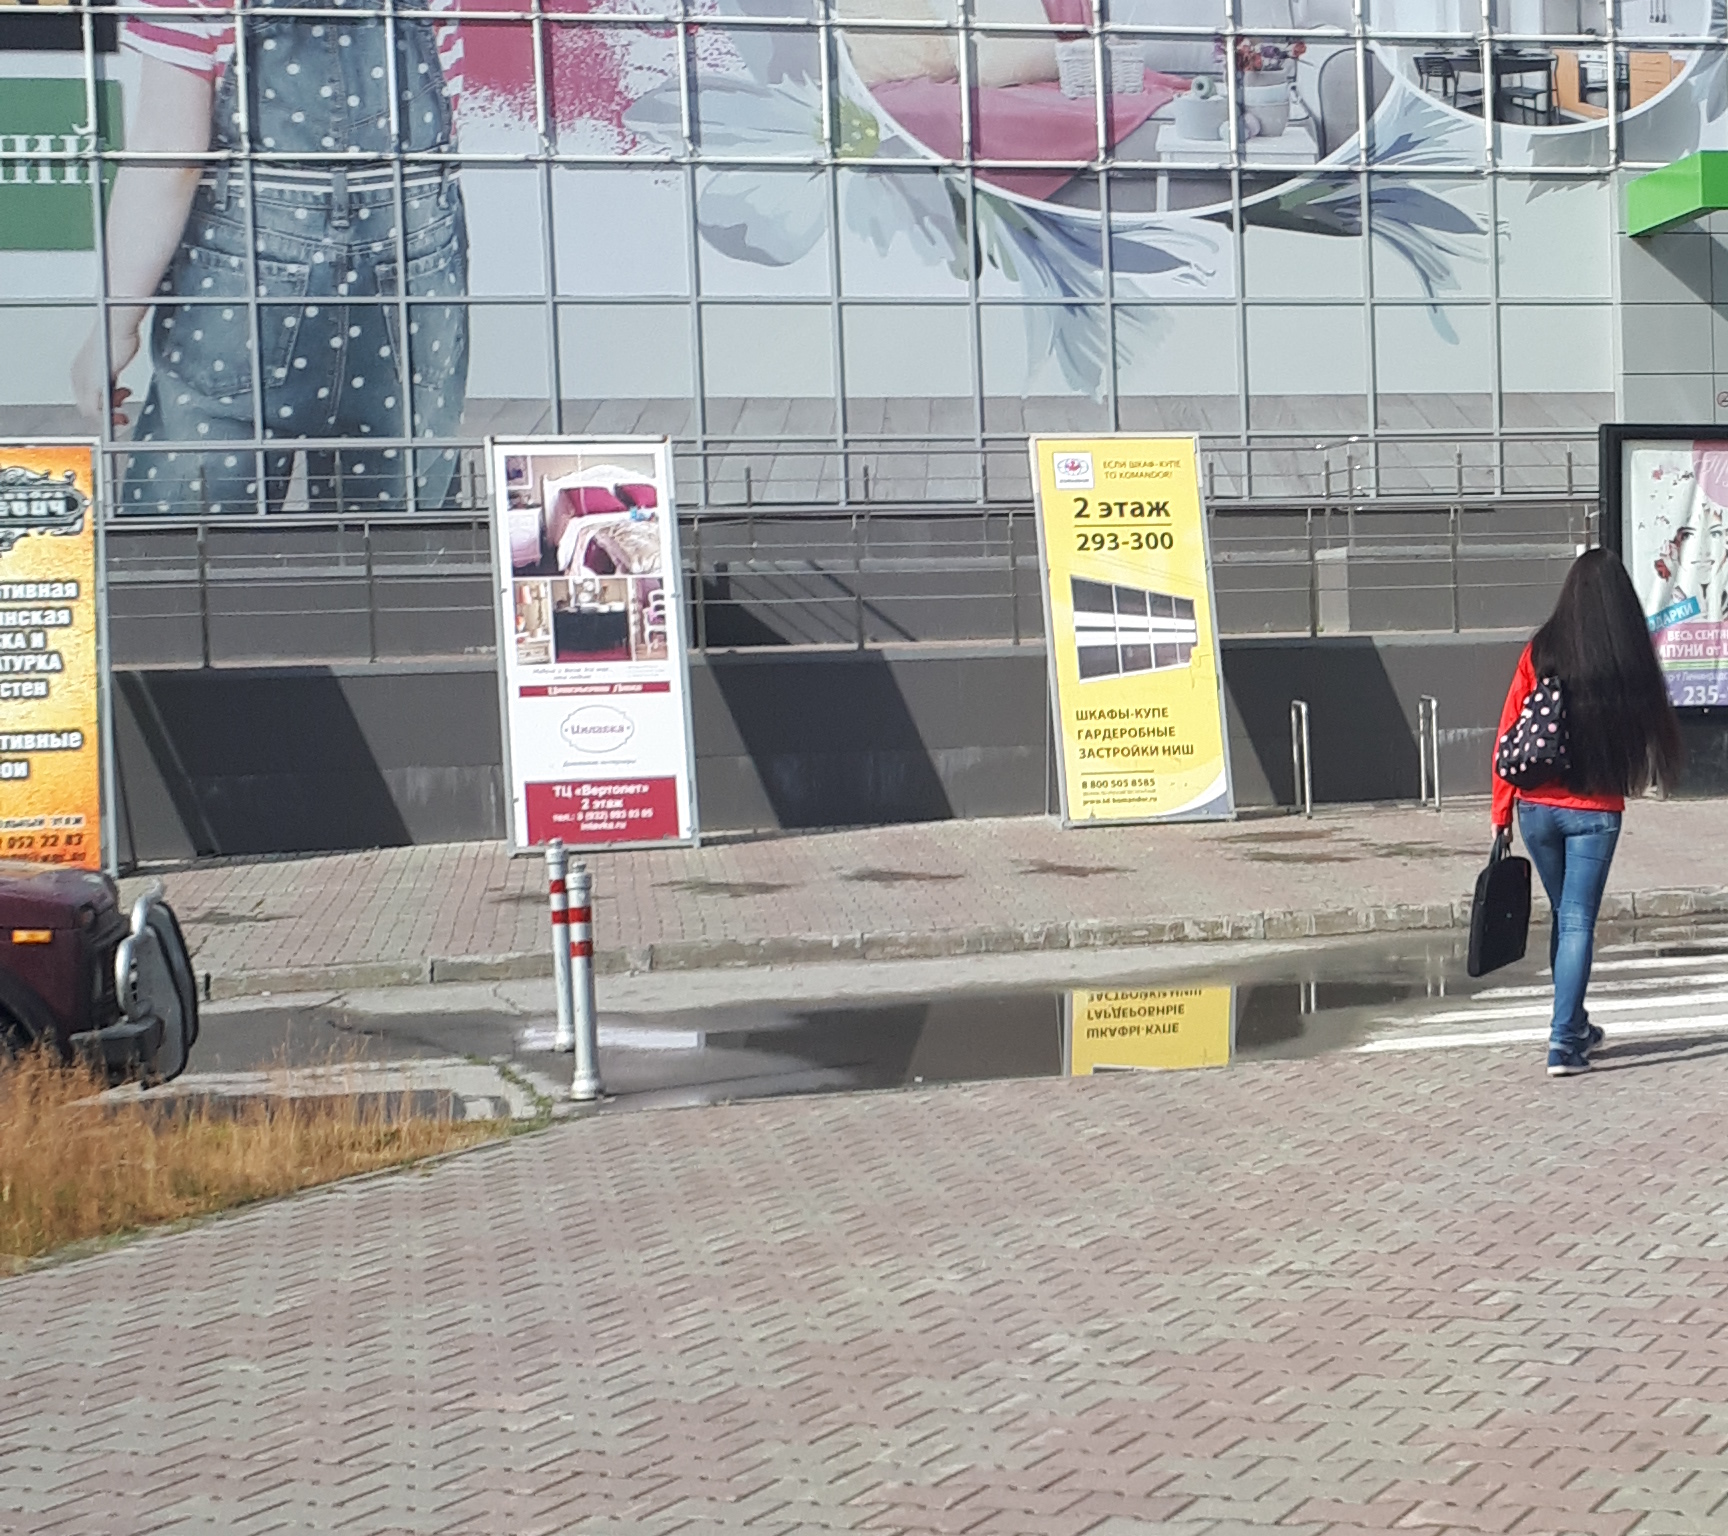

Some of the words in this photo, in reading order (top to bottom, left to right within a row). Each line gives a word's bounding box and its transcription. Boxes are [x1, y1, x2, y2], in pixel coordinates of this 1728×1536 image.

[1073, 497, 1090, 518] 2
[1098, 501, 1171, 518] этаж
[1076, 532, 1174, 551] 293-300
[1648, 603, 1693, 631] ОДАРКИ
[1667, 630, 1693, 641] ВЕСЬ
[1076, 707, 1169, 721] ШКАФЫ-КУПЕ
[1077, 726, 1176, 741] ГАРДЕРОБНЫЕ
[1079, 745, 1159, 759] ЗАСТРОЙКИ
[1162, 744, 1194, 756] НИШ
[552, 785, 572, 799] ТЦ
[574, 784, 650, 797] «Вертолет»
[1082, 781, 1088, 789] 8
[1090, 780, 1109, 789] 800
[581, 798, 590, 810] 2
[592, 798, 624, 809] этаж
